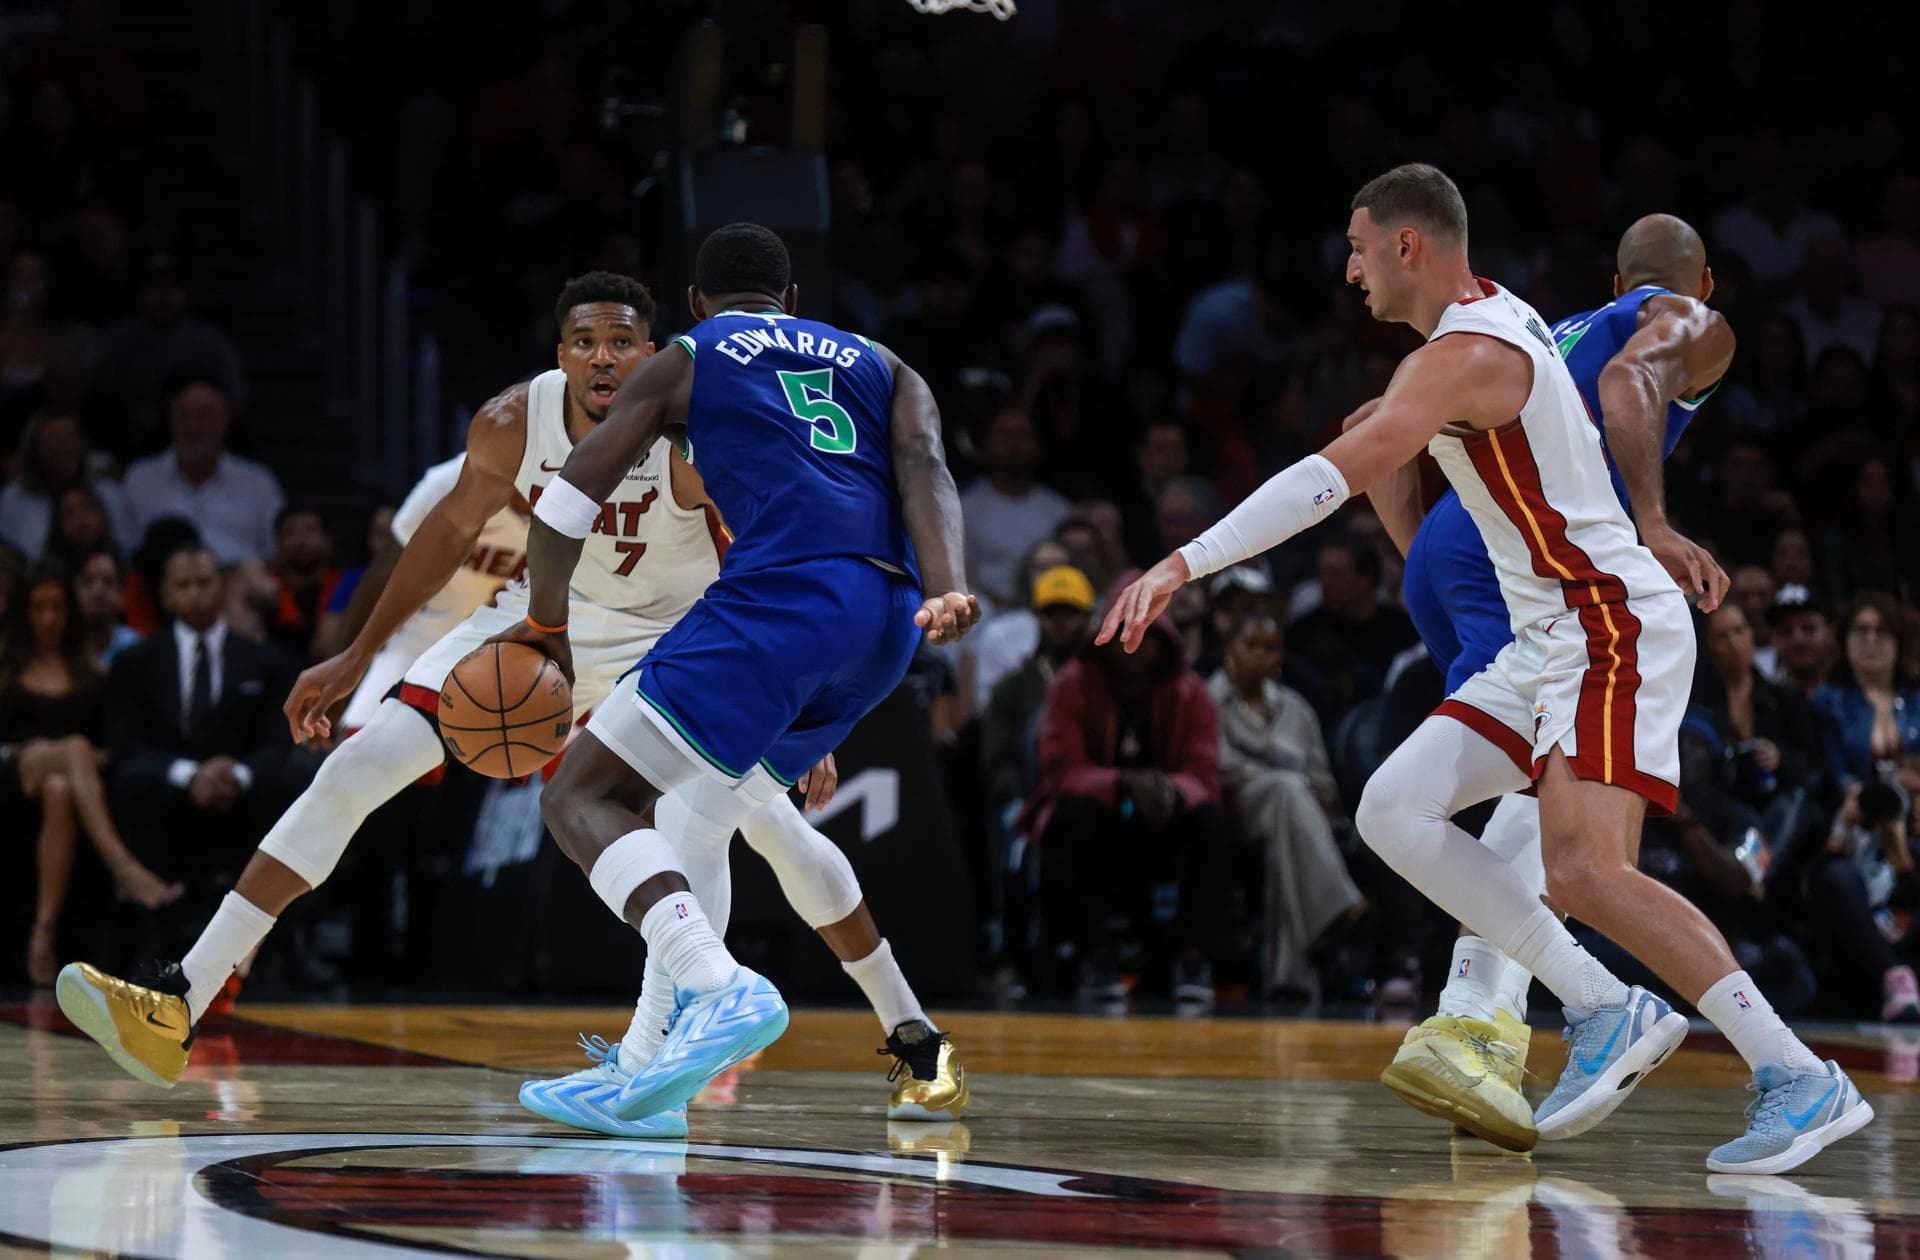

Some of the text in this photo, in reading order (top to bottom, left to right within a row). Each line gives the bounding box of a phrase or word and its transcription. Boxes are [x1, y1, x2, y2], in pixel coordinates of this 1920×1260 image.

[715, 328, 860, 368] EDWARDS
[776, 367, 857, 454] 5
[613, 541, 648, 577] 7
